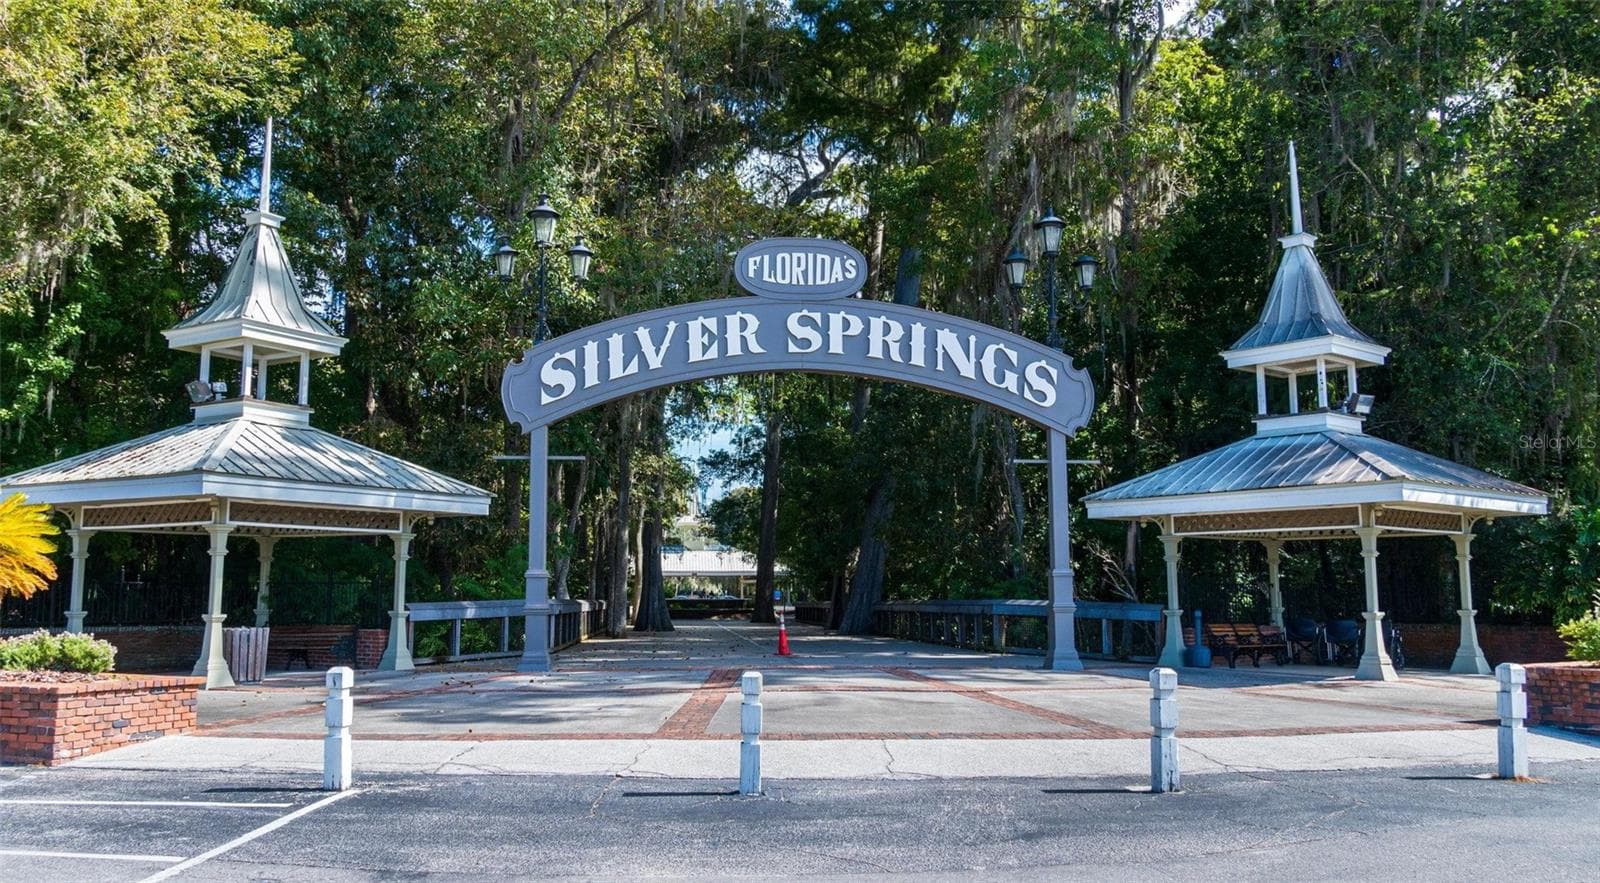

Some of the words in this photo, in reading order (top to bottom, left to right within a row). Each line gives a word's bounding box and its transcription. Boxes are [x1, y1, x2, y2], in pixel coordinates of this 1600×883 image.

[747, 252, 857, 286] FLORIDA'S
[540, 310, 767, 405] SILVER
[786, 309, 1058, 408] SPRINGS
